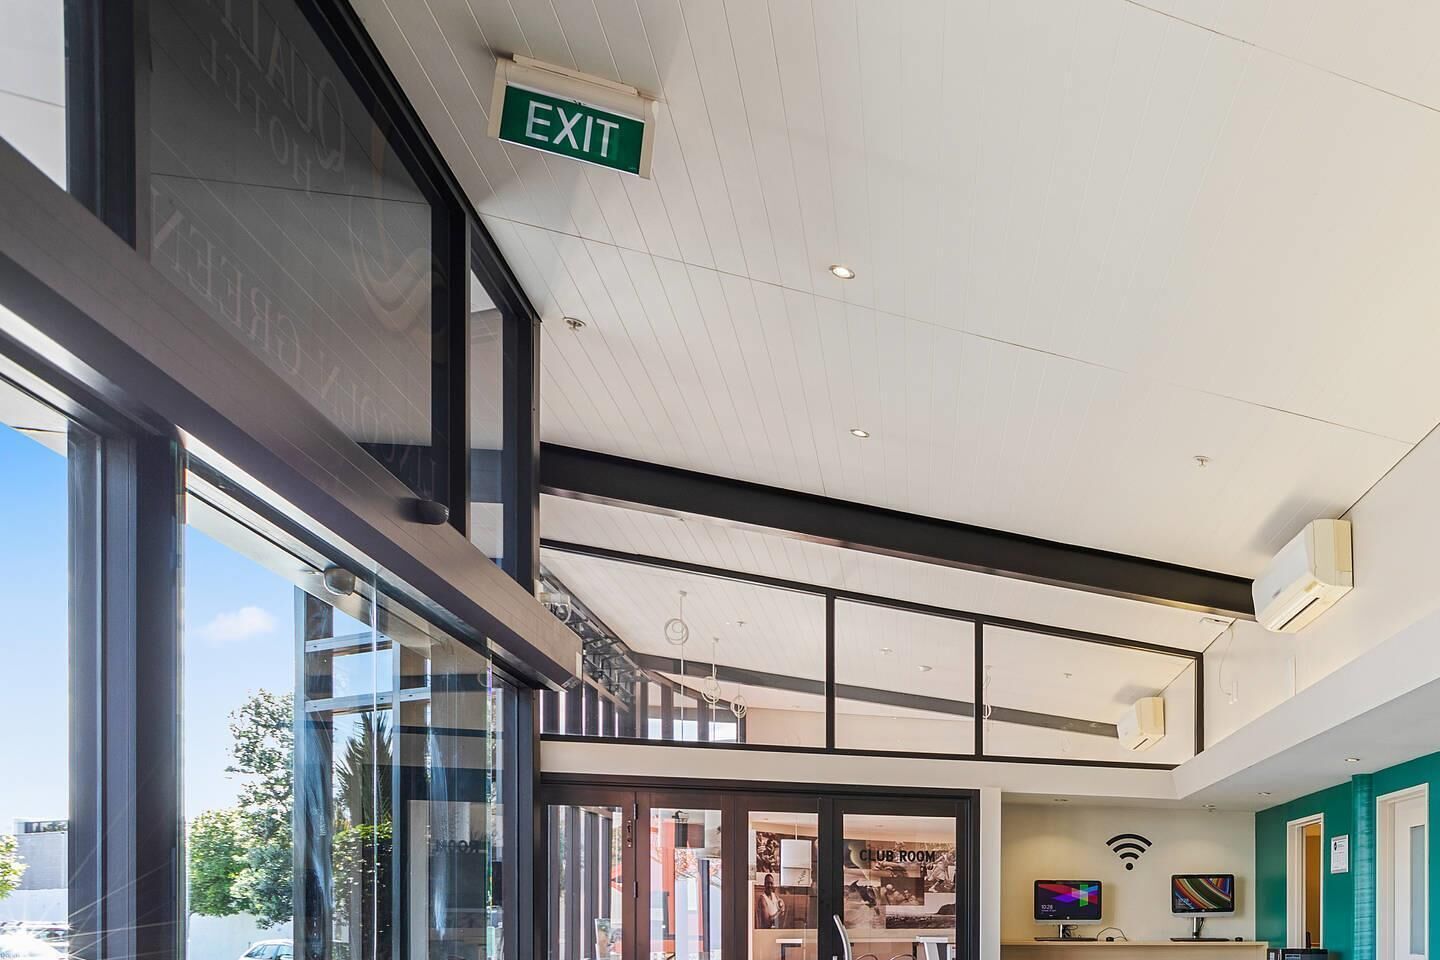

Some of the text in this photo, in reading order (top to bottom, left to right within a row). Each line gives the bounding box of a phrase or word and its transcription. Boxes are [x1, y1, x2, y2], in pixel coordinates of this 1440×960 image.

[525, 100, 620, 158] EXIT
[860, 850, 936, 862] CLUB ROOM
